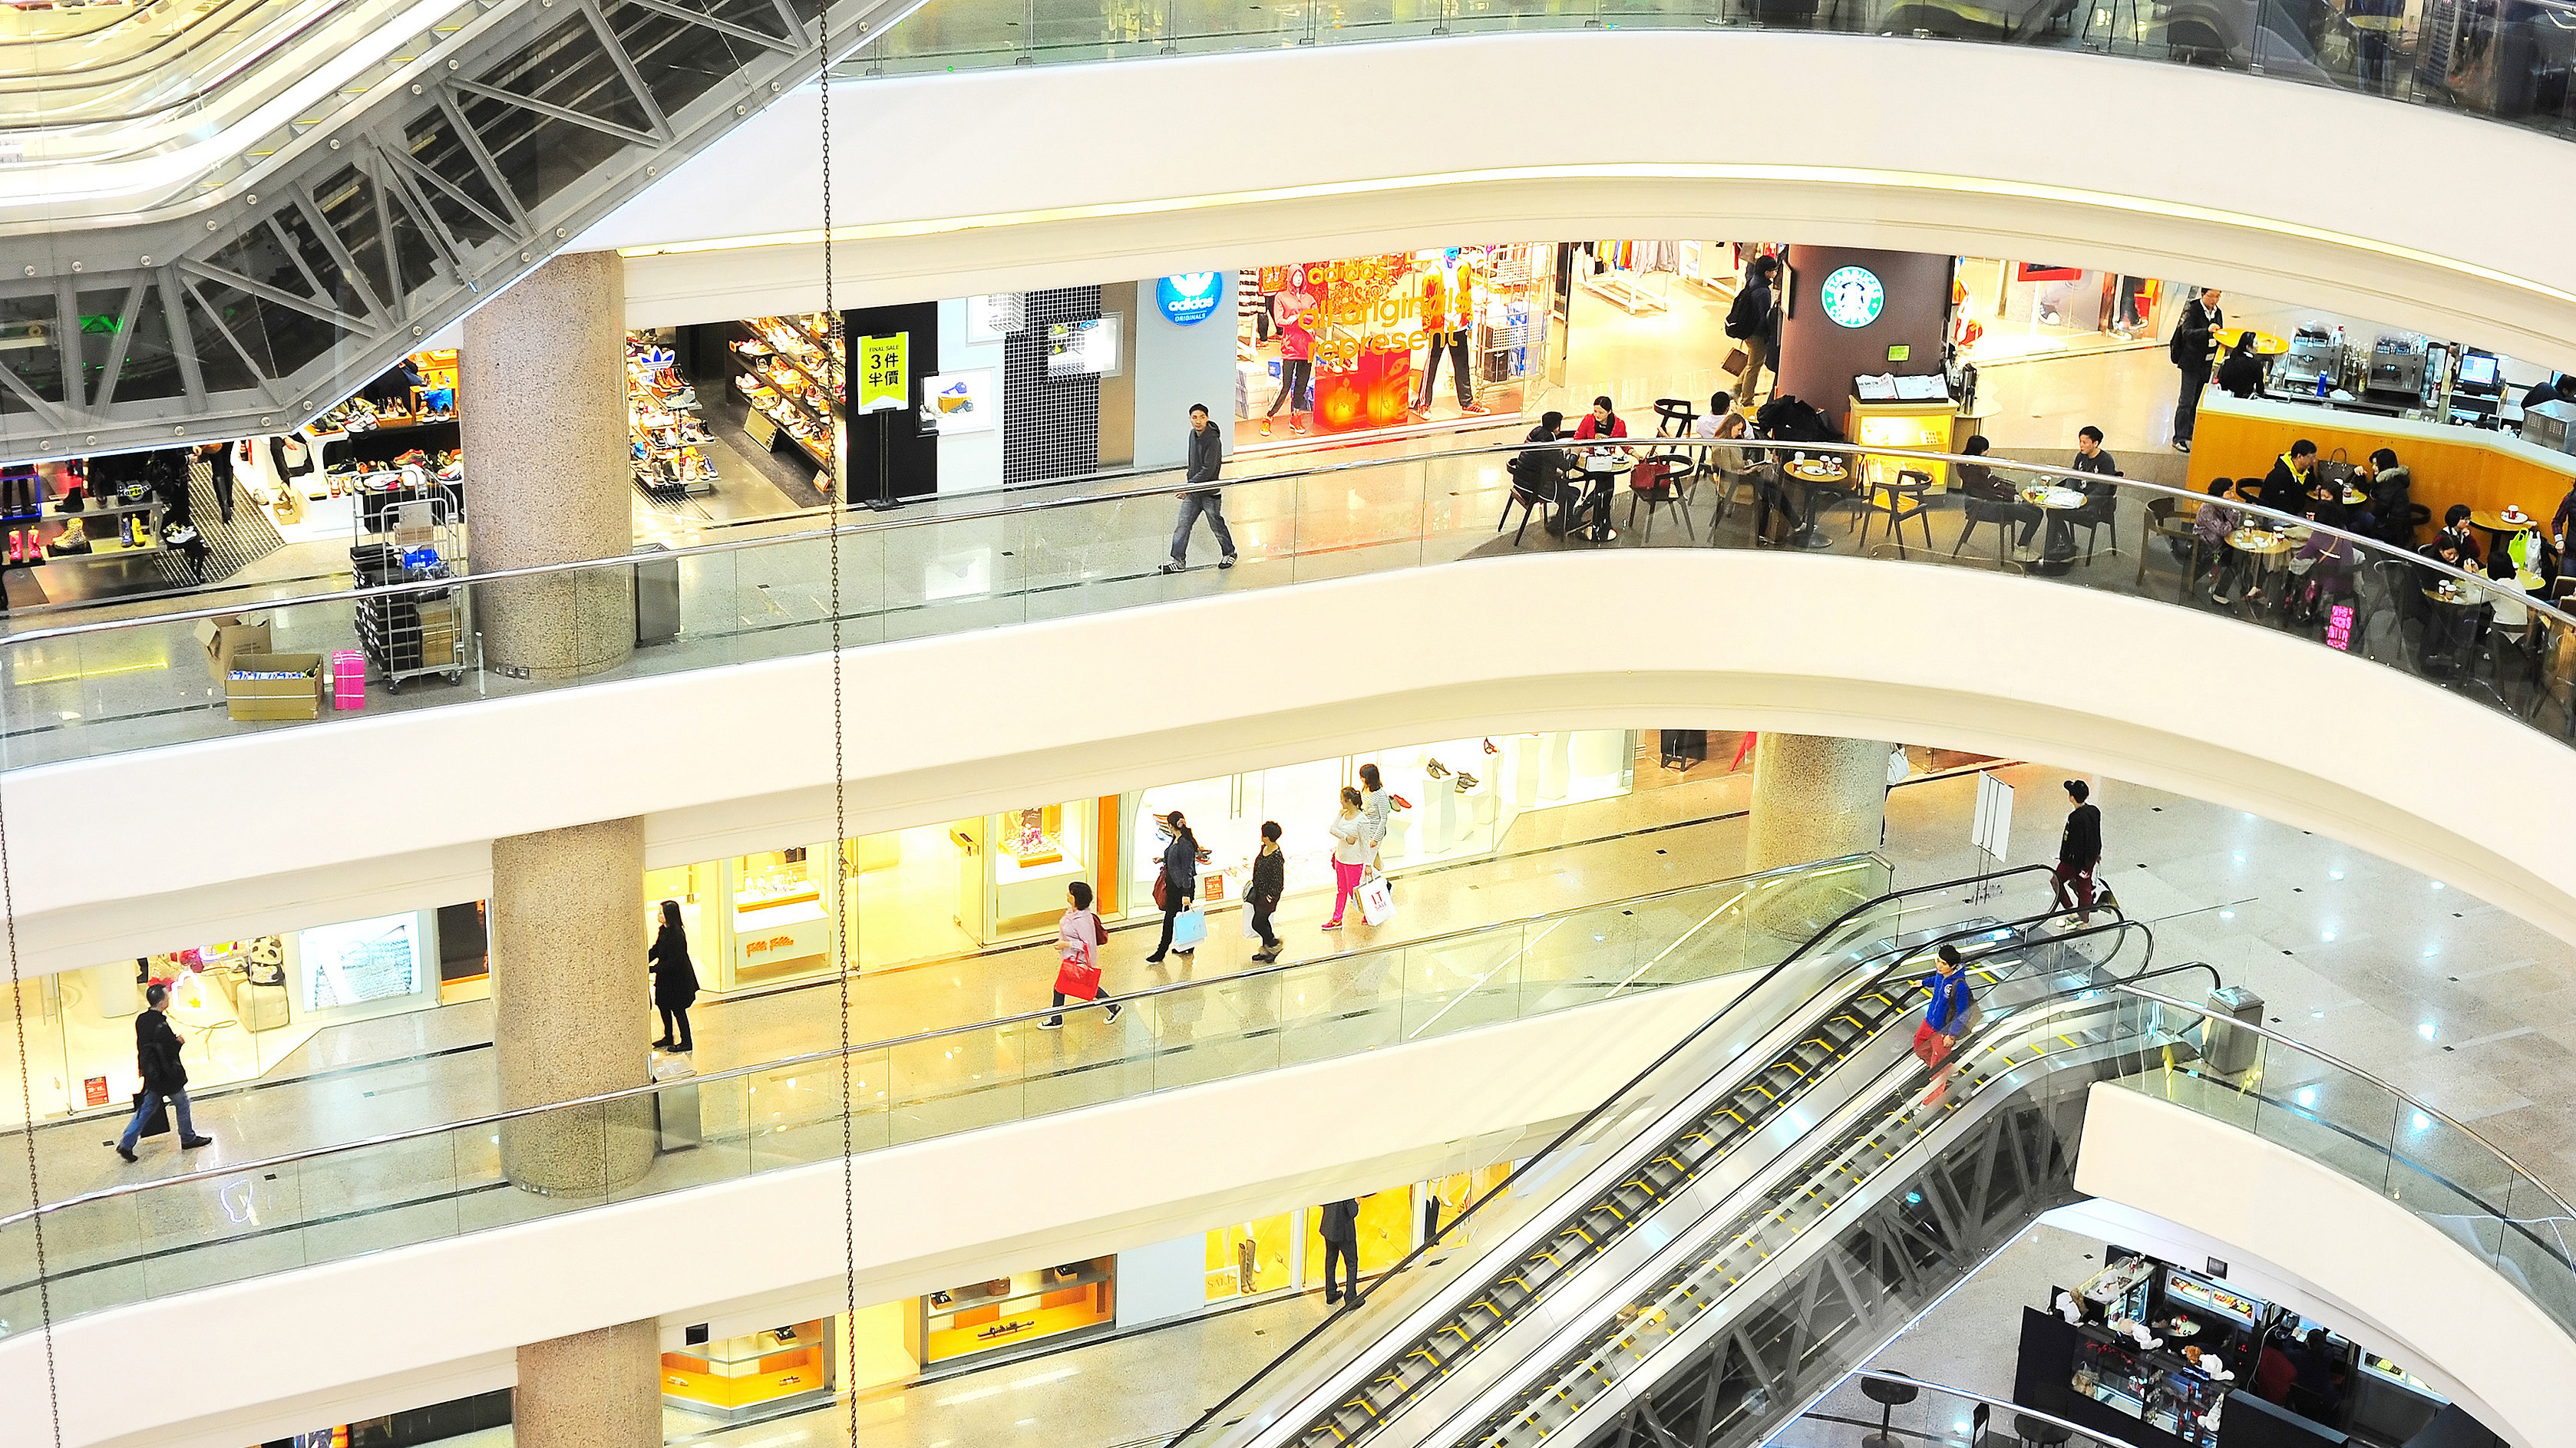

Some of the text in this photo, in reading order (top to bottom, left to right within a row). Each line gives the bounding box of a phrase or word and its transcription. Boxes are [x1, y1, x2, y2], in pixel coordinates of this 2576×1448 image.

[1307, 257, 1388, 285] adidas
[1168, 295, 1214, 312] adidas
[1299, 286, 1473, 331] all originals
[1174, 312, 1207, 322] ORIGINALS
[1307, 321, 1458, 367] represent
[869, 370, 899, 388] 半價
